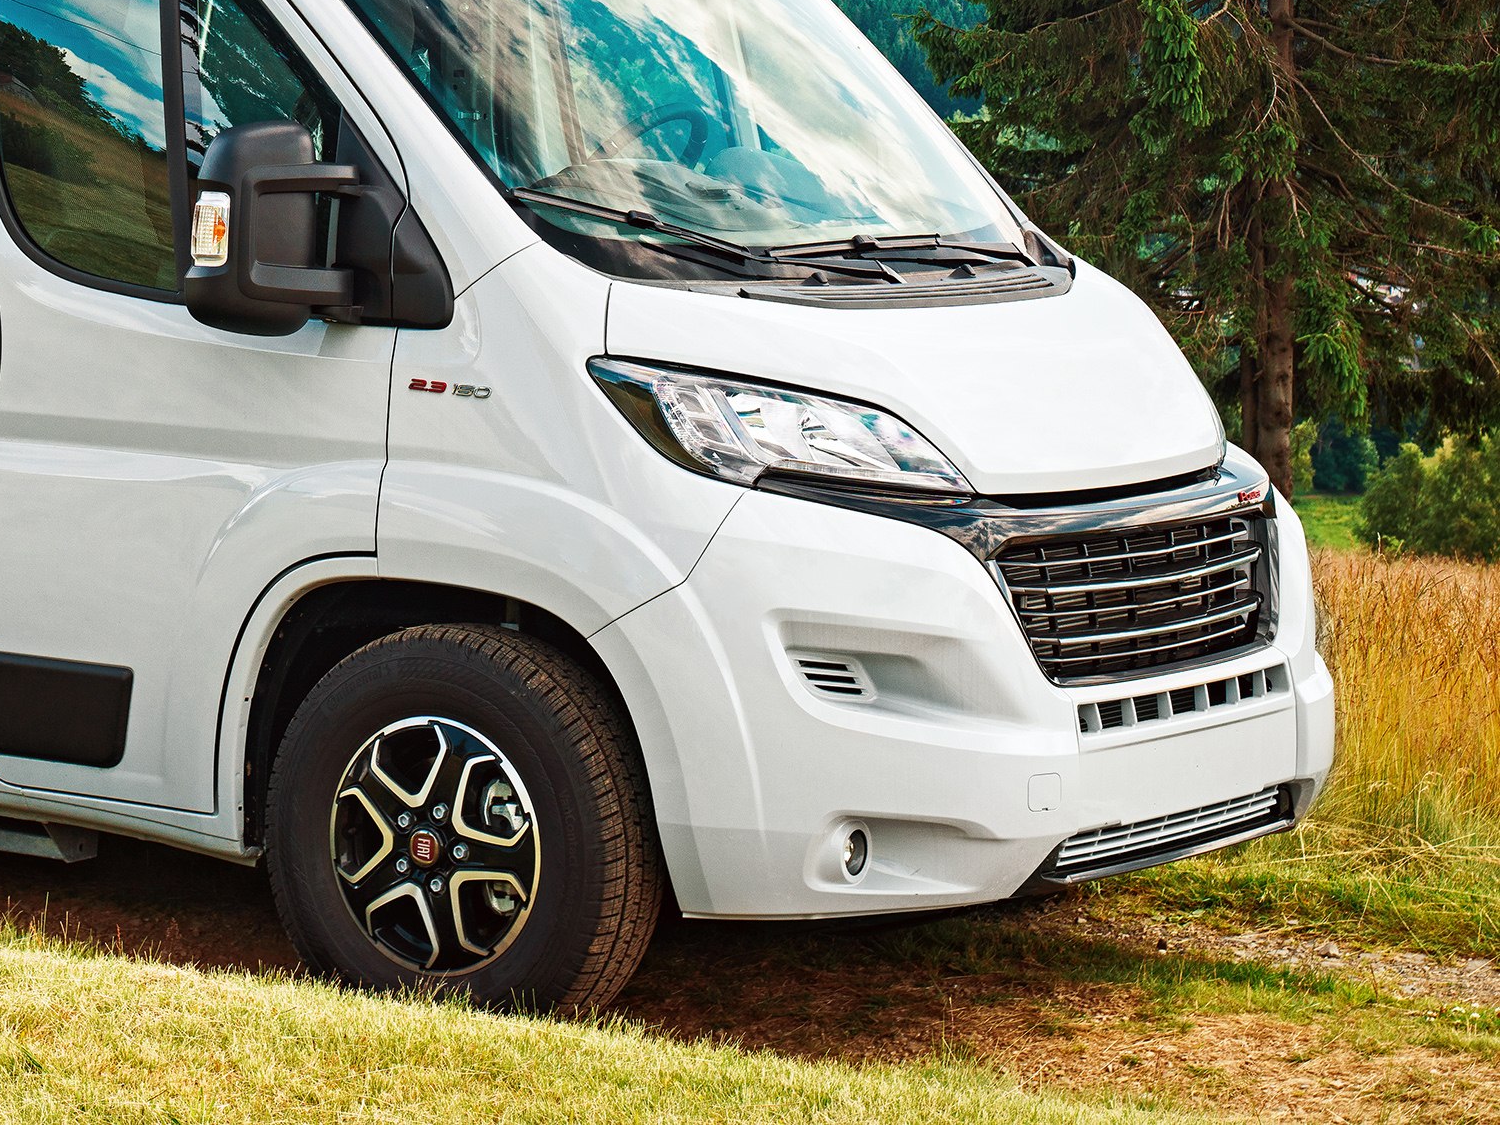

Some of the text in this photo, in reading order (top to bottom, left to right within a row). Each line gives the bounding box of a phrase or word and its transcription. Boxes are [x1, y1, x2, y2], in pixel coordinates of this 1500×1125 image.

[408, 378, 492, 398] 2.3 150
[417, 837, 431, 860] FIAT
